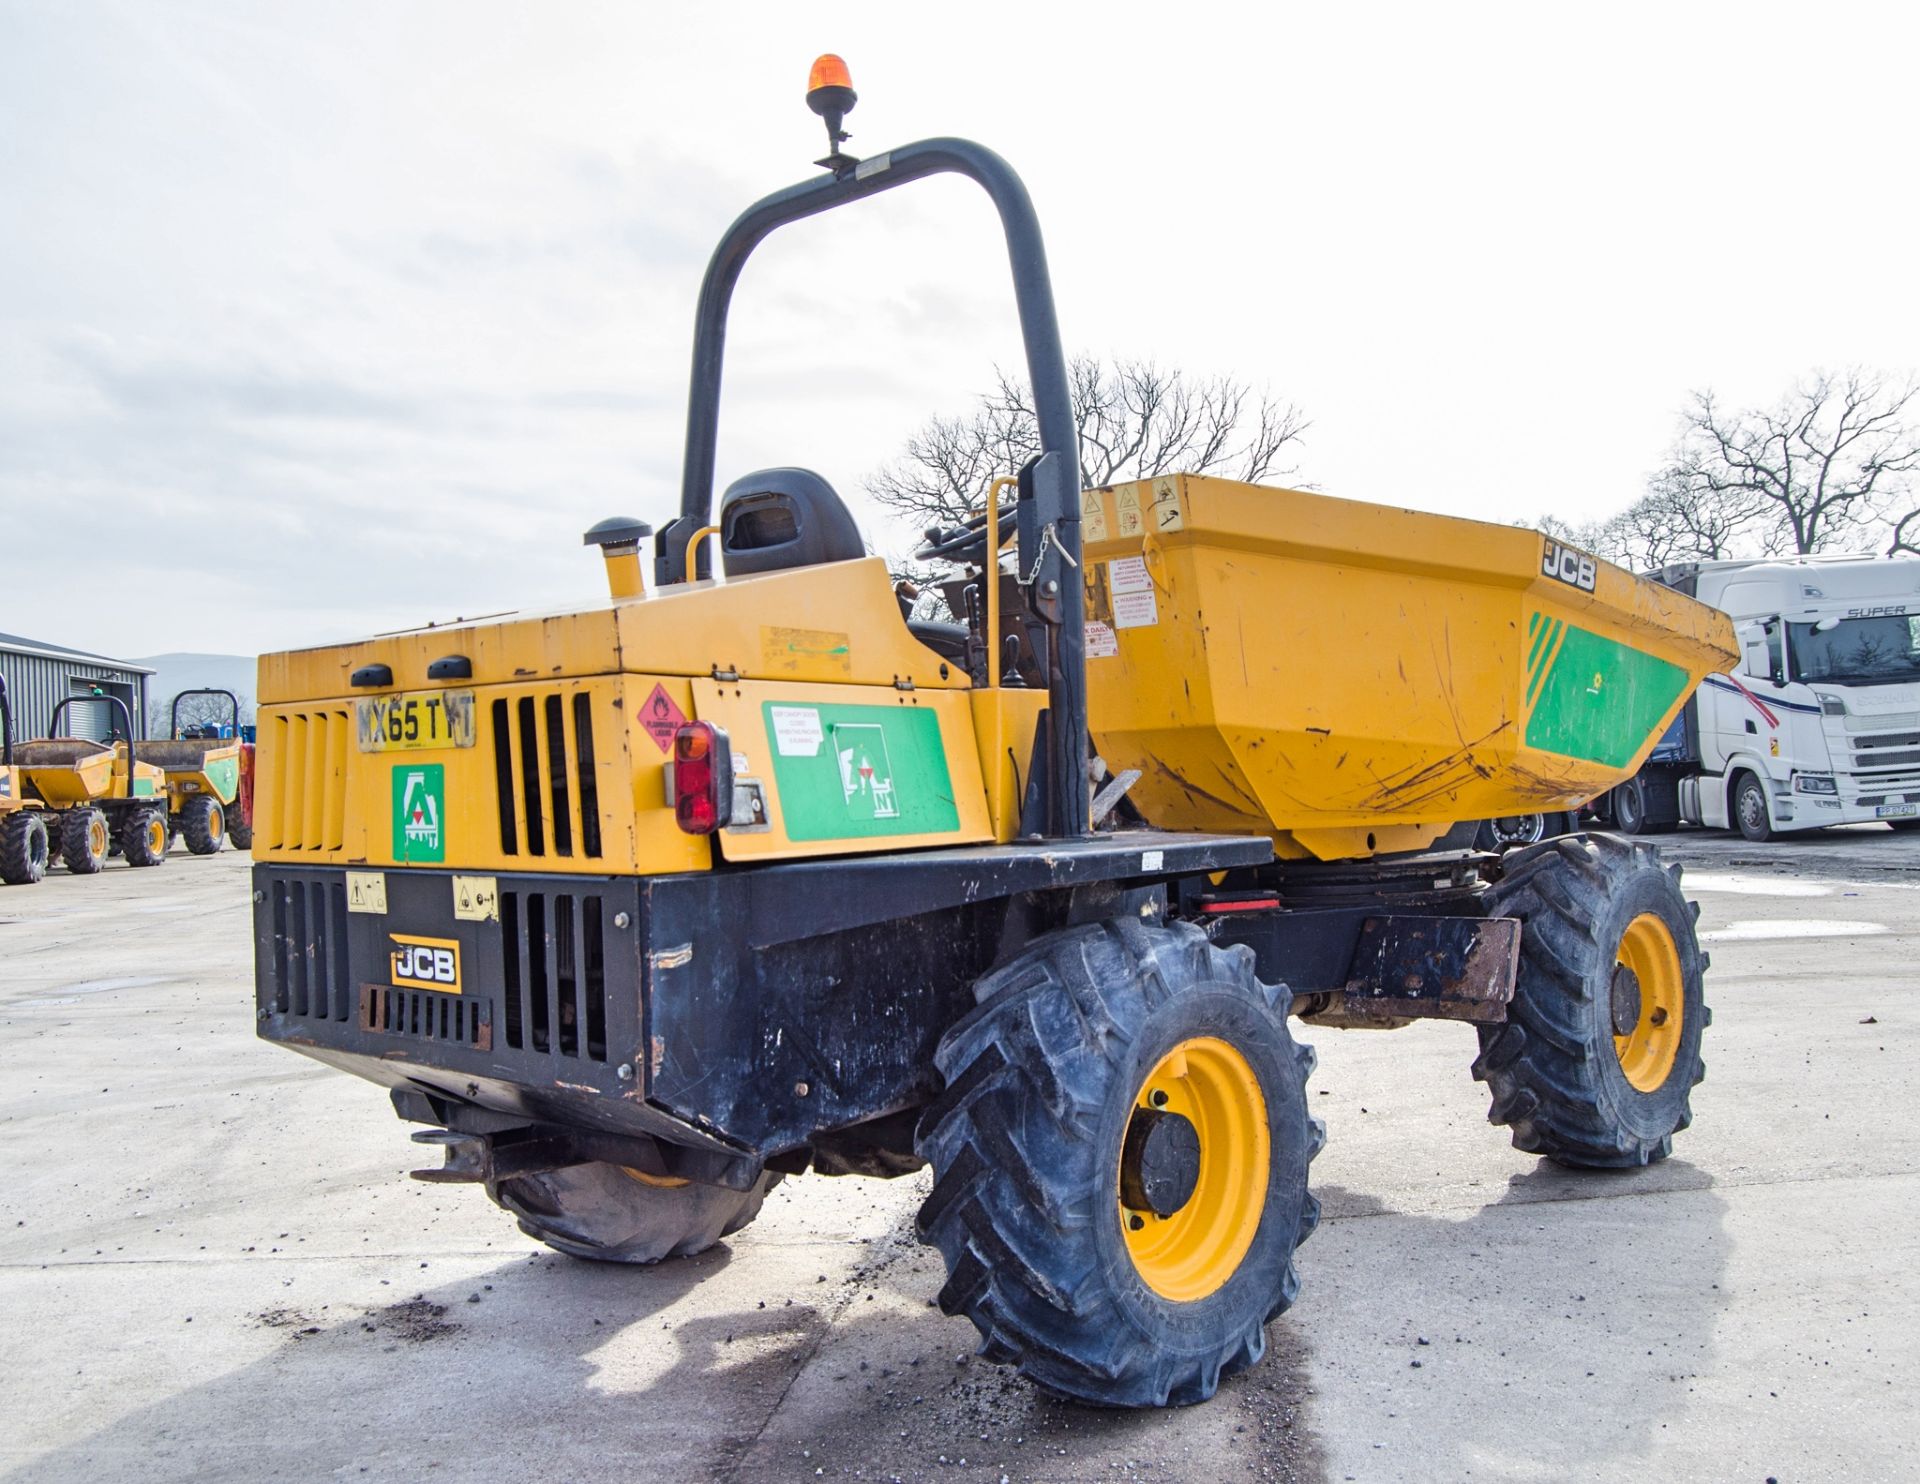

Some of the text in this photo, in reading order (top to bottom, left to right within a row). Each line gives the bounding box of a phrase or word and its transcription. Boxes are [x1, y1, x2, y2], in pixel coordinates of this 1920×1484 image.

[1543, 545, 1596, 590] JCB
[1848, 605, 1906, 619] SUPER
[397, 946, 455, 982] JCB
